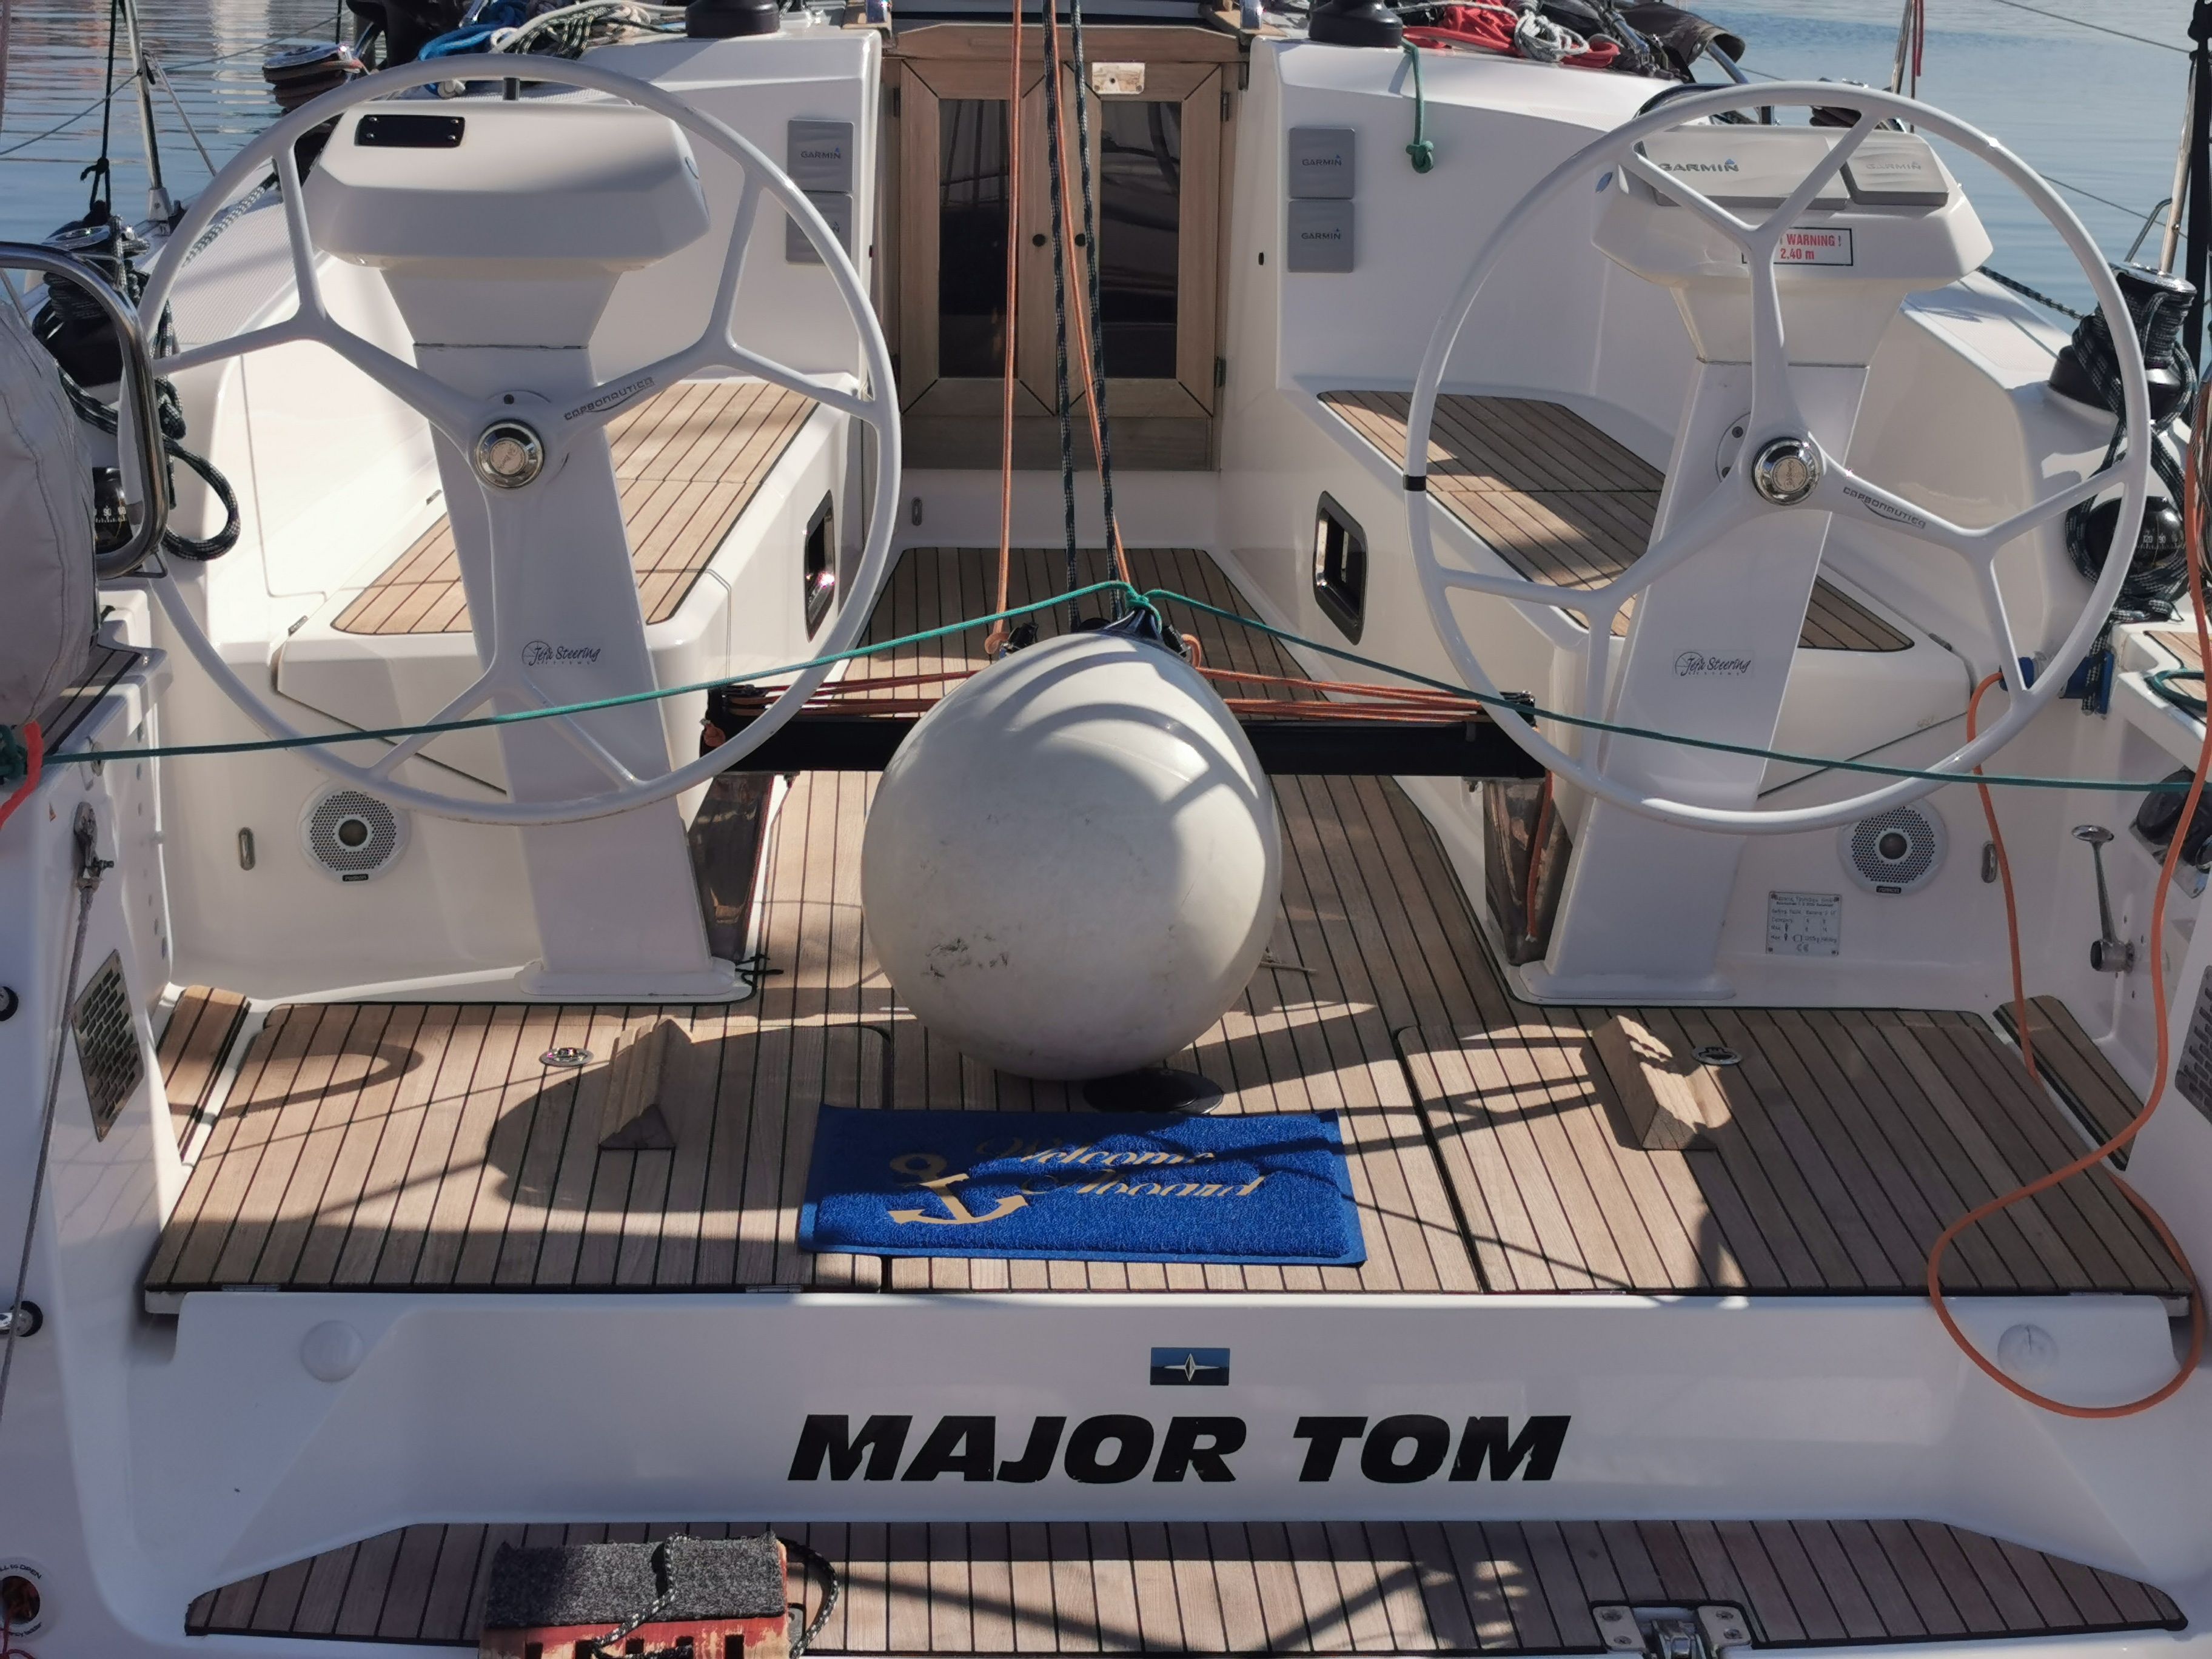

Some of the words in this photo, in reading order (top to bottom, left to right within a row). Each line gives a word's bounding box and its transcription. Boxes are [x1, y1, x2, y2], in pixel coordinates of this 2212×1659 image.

[800, 151, 841, 159] GARMIN
[1658, 163, 1739, 172] GARMIN
[1786, 233, 1836, 247] WARNING
[555, 646, 601, 662] Steering
[1707, 657, 1751, 674] Steering
[788, 1413, 1247, 1484] MAJOR
[1293, 1414, 1572, 1484] TOM
